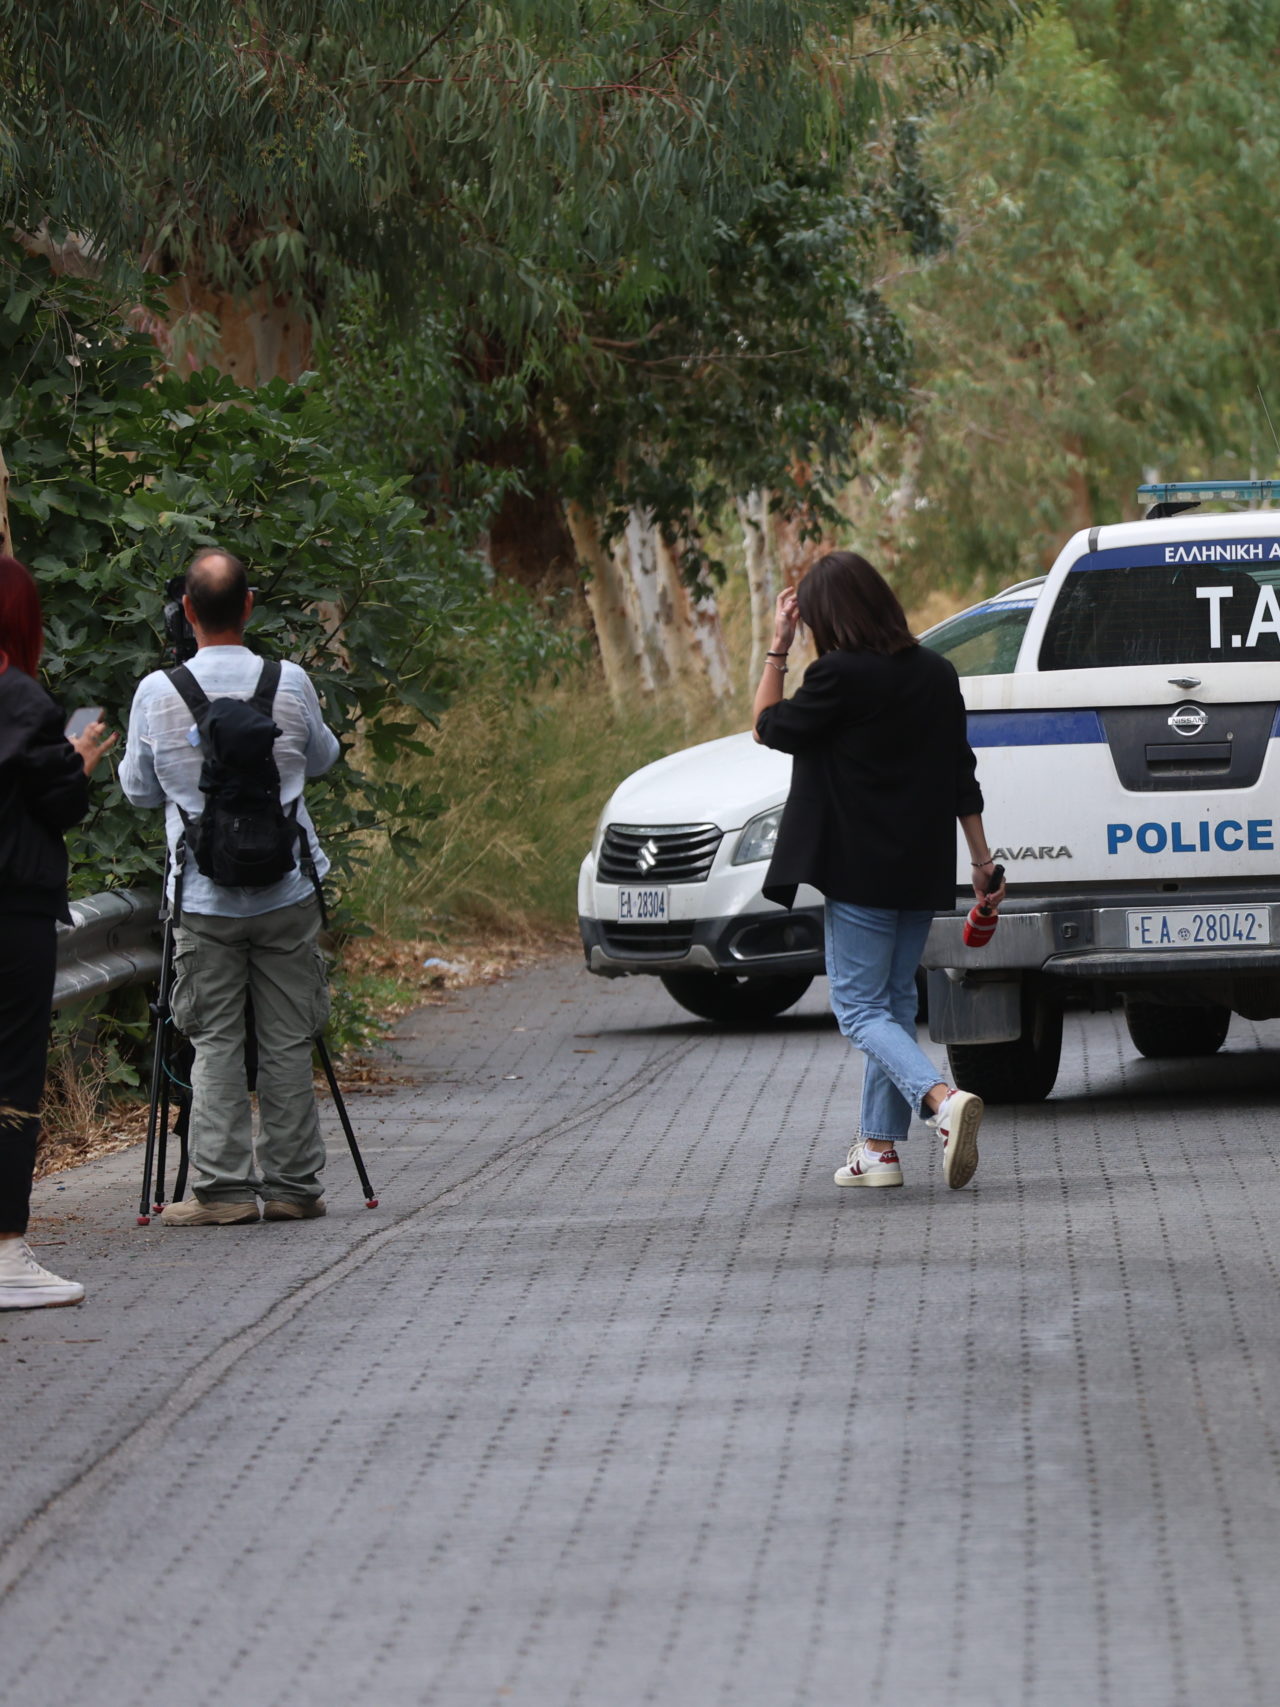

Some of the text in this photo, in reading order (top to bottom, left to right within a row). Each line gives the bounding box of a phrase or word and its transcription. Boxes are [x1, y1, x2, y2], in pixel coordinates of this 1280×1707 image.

[1164, 543, 1264, 563] ΕΛΛΗΝΙΚΗ
[1171, 716, 1204, 724] NISSAN
[1106, 819, 1275, 855] POLICE
[988, 845, 1073, 861] AVARA
[638, 891, 665, 918] 28304
[1192, 912, 1257, 943] 28042
